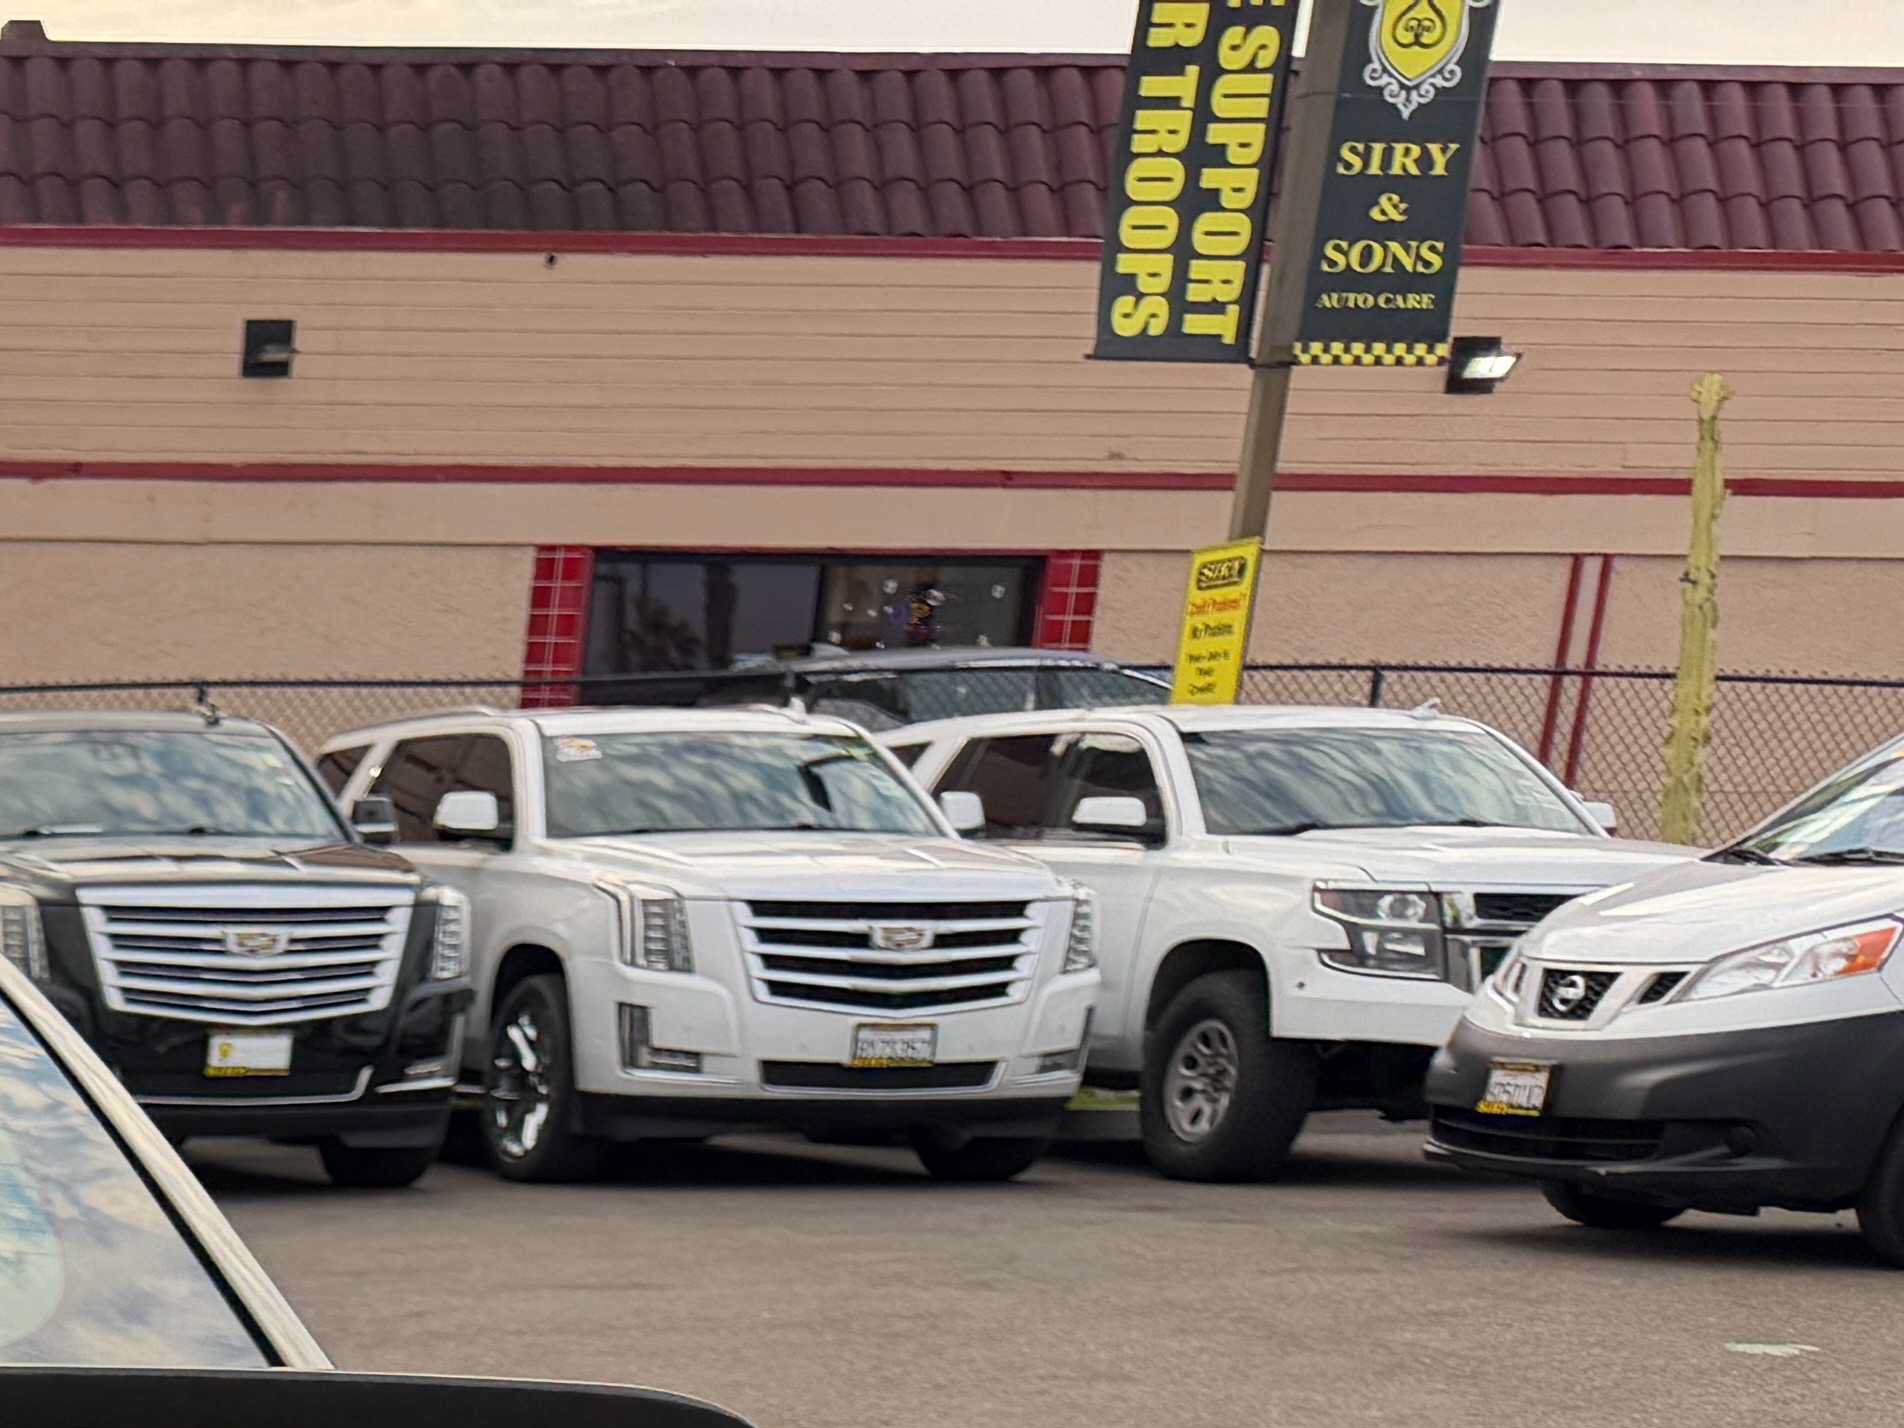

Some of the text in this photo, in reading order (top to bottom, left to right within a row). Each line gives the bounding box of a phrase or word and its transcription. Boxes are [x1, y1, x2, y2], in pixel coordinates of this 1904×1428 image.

[1336, 142, 1461, 177] SIRY
[1110, 65, 1200, 338] TROOPS
[1181, 25, 1281, 345] SUPPORT
[1369, 191, 1410, 222] &
[1320, 239, 1445, 275] SONS
[1315, 292, 1436, 311] AUTO CARE
